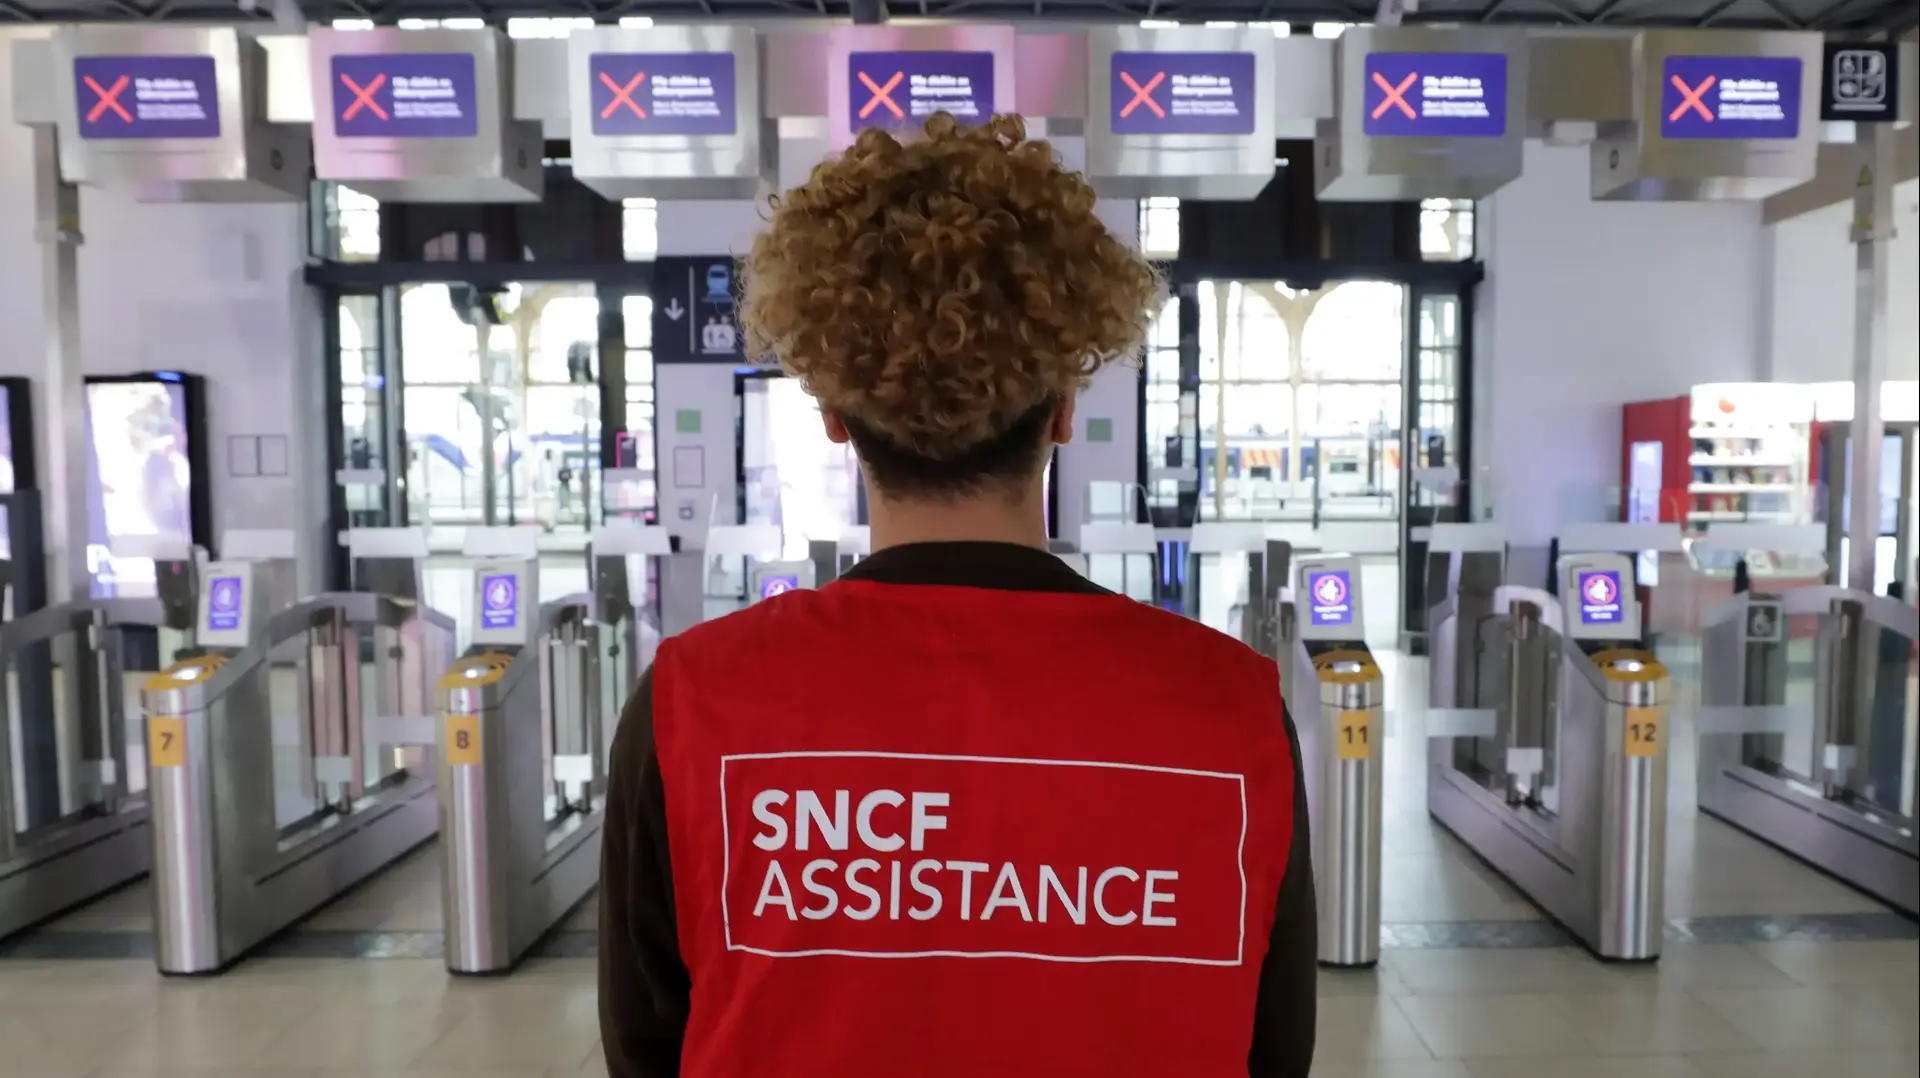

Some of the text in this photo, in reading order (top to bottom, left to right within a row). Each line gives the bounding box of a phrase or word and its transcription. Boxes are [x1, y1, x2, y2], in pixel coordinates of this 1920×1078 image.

[160, 732, 173, 752] 7
[456, 730, 470, 750] 8
[1342, 725, 1368, 744] 11
[1630, 722, 1656, 742] 12
[752, 789, 950, 852] SNCF
[753, 858, 1179, 926] ASSISTANCE
